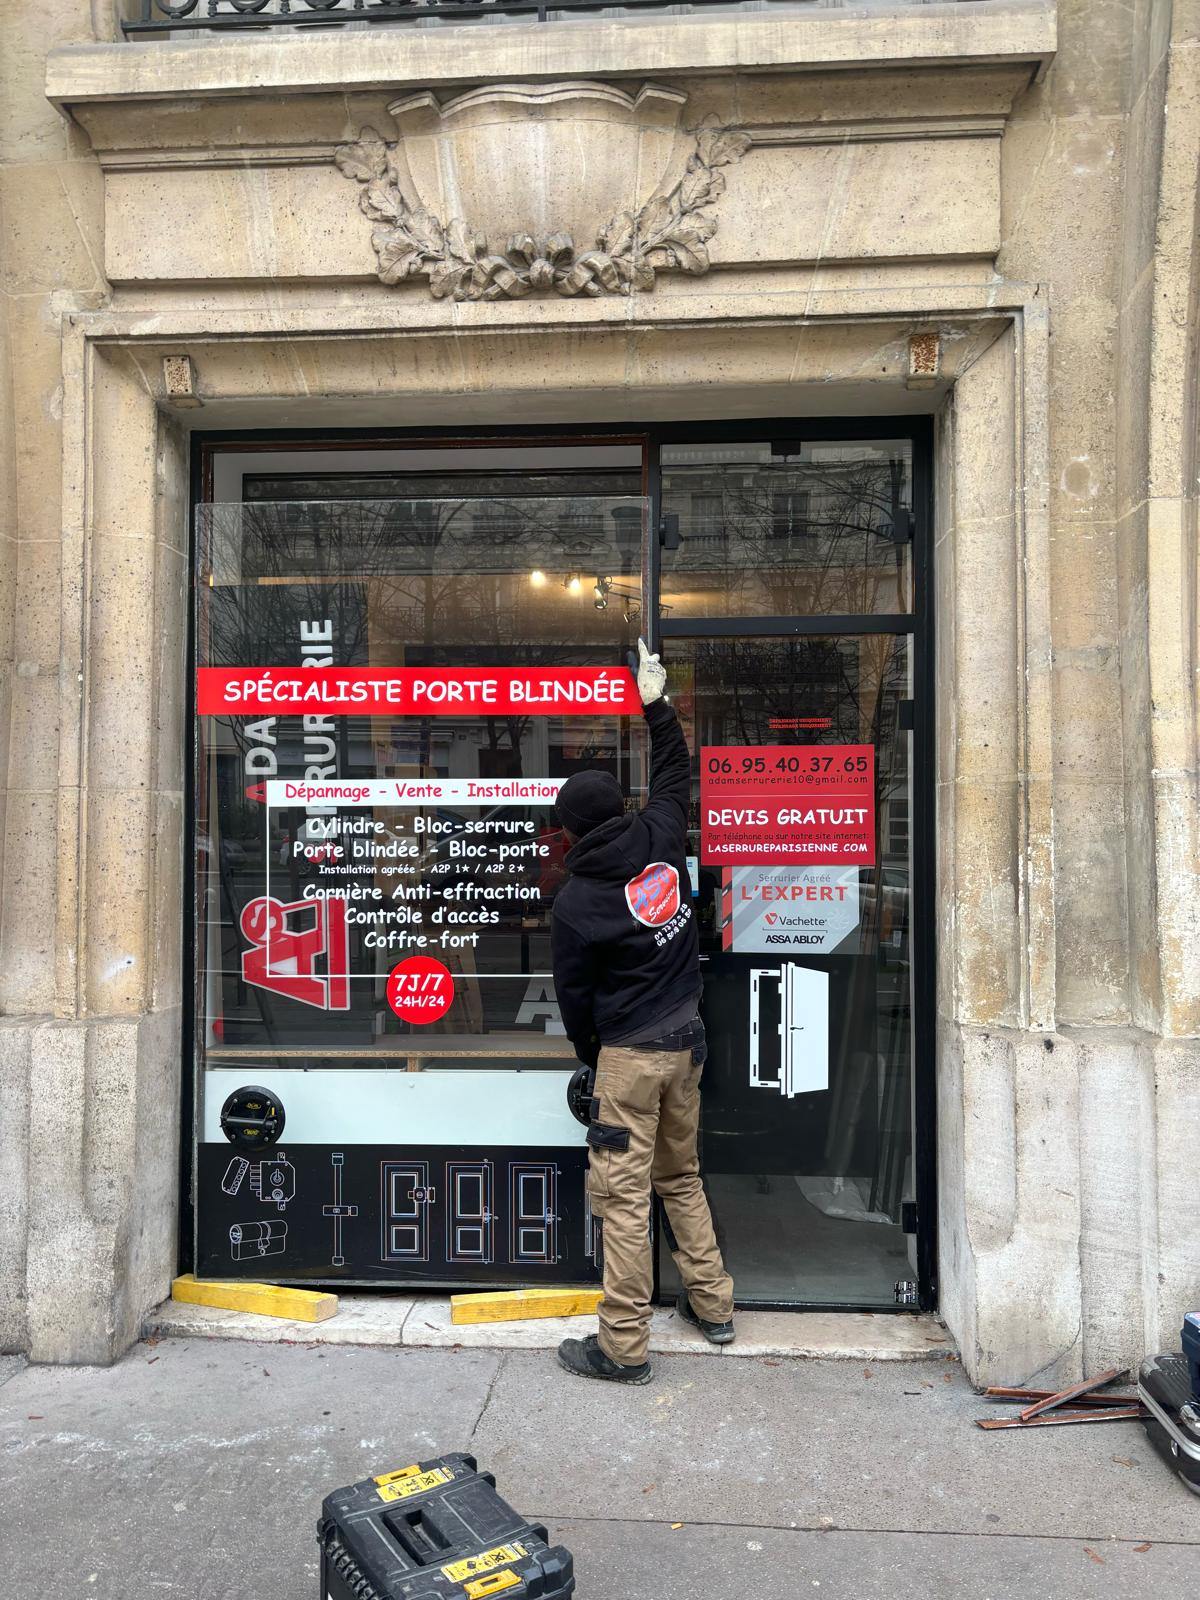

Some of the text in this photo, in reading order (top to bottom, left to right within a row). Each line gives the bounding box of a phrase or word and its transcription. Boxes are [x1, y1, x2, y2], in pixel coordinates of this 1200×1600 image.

[223, 671, 402, 703] SPÉCIALISTE
[412, 679, 498, 703] PORTE
[509, 671, 626, 703] BLINDÉE
[708, 756, 868, 774] 06.95.40.37.65
[708, 774, 868, 786] adamserrurerie10@gmail.com
[285, 782, 371, 803] Dépannage
[395, 783, 442, 798] Vente
[467, 781, 560, 799] Installation
[708, 808, 769, 826] DEVIS
[776, 808, 868, 825] GRATUIT
[308, 817, 385, 838] Cylindre
[414, 816, 535, 834] Bloc-serrure
[707, 832, 721, 841] Par
[790, 832, 813, 840] notre
[815, 832, 831, 840] site
[293, 840, 345, 858] Porte
[353, 839, 420, 858] blindée
[449, 839, 550, 862] Bloc-porte
[708, 843, 868, 854] LASERRUREPARISIENNE.COM
[318, 864, 377, 874] Installation
[380, 864, 416, 877] agréée
[430, 864, 451, 874] A2P
[484, 864, 505, 873] A2P
[757, 871, 831, 884] Serrurier Agréé
[302, 882, 541, 901] Cornière Anti-effraction
[741, 885, 848, 901] L'EXPERT
[344, 904, 500, 925] Contrôle d'accès
[779, 916, 826, 927] Vachette
[364, 930, 480, 949] Coffre-fort
[765, 934, 825, 945] ASSA ABLOY
[394, 973, 445, 992] 7J/7
[395, 994, 445, 1009] 24H/24
